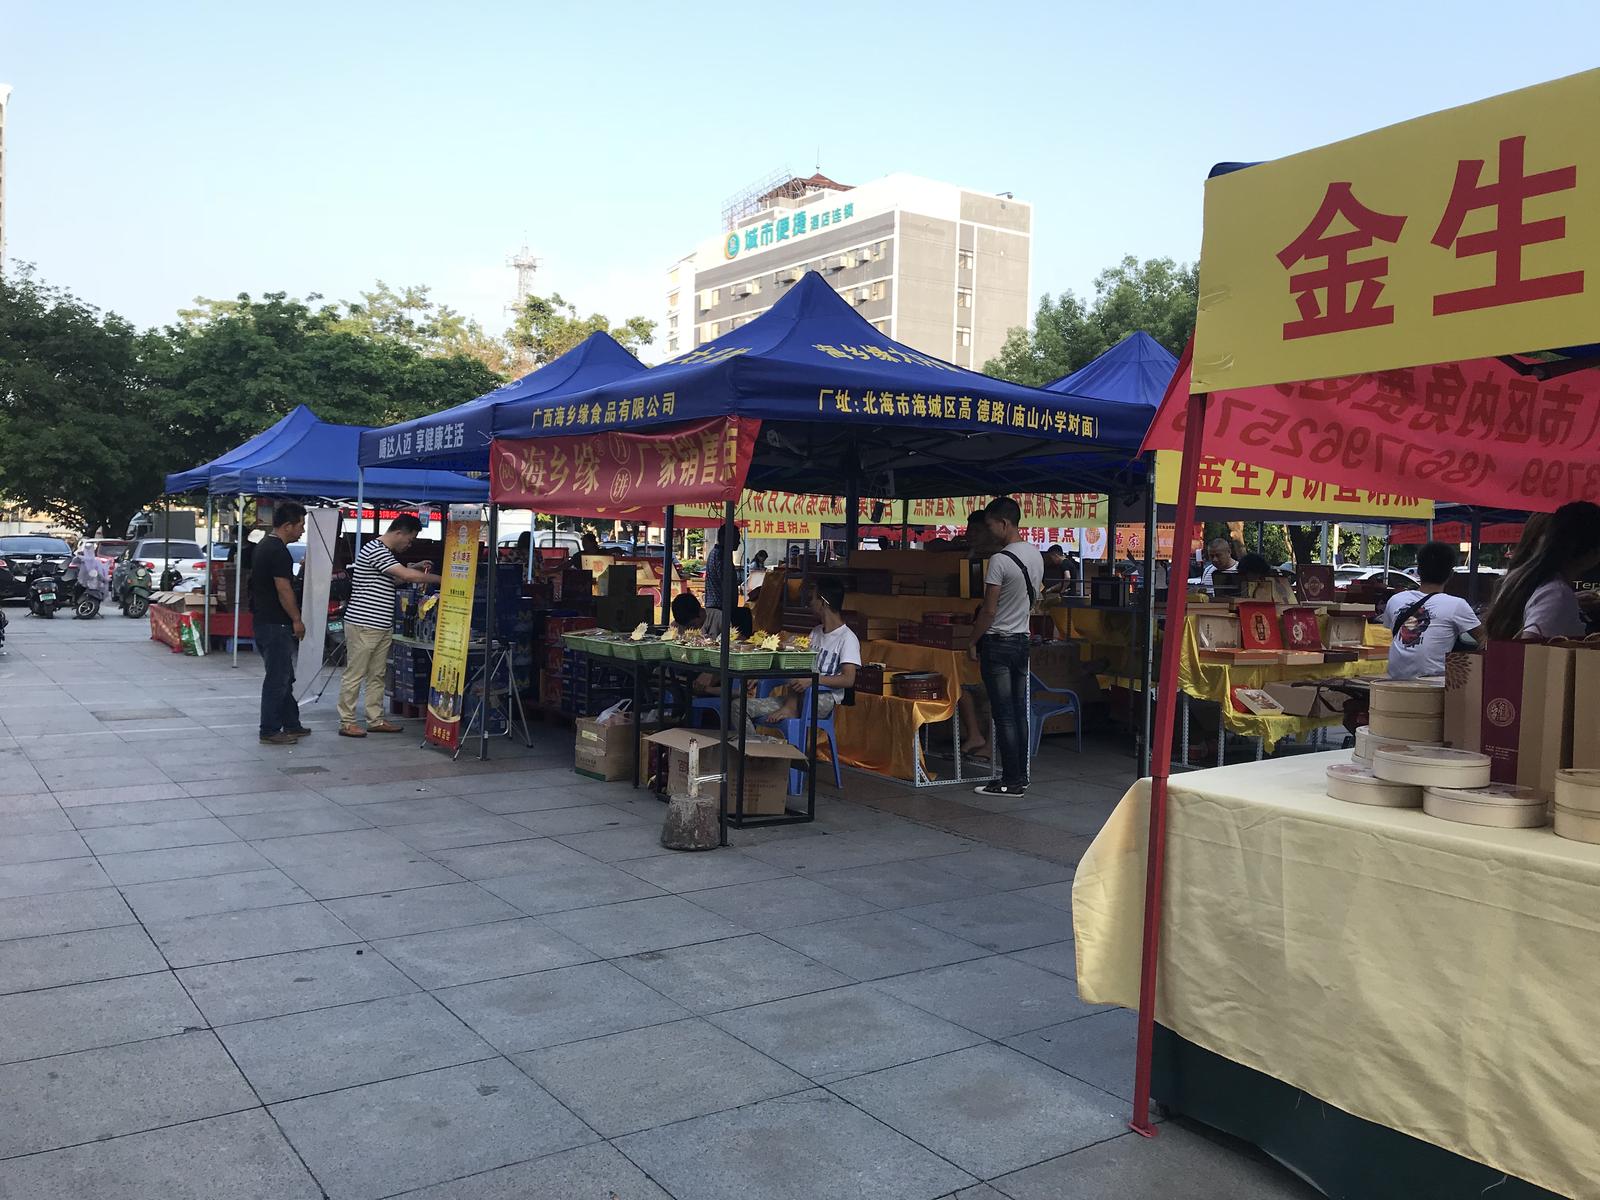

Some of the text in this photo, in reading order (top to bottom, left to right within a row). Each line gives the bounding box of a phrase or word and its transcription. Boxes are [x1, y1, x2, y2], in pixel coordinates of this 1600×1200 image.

[744, 210, 807, 251] 城市便捷
[1275, 135, 1585, 341] 金生
[531, 391, 676, 429] 广西海乡缘食品有限公司
[415, 422, 465, 453] 享健康生活
[520, 443, 600, 497] 海乡缘
